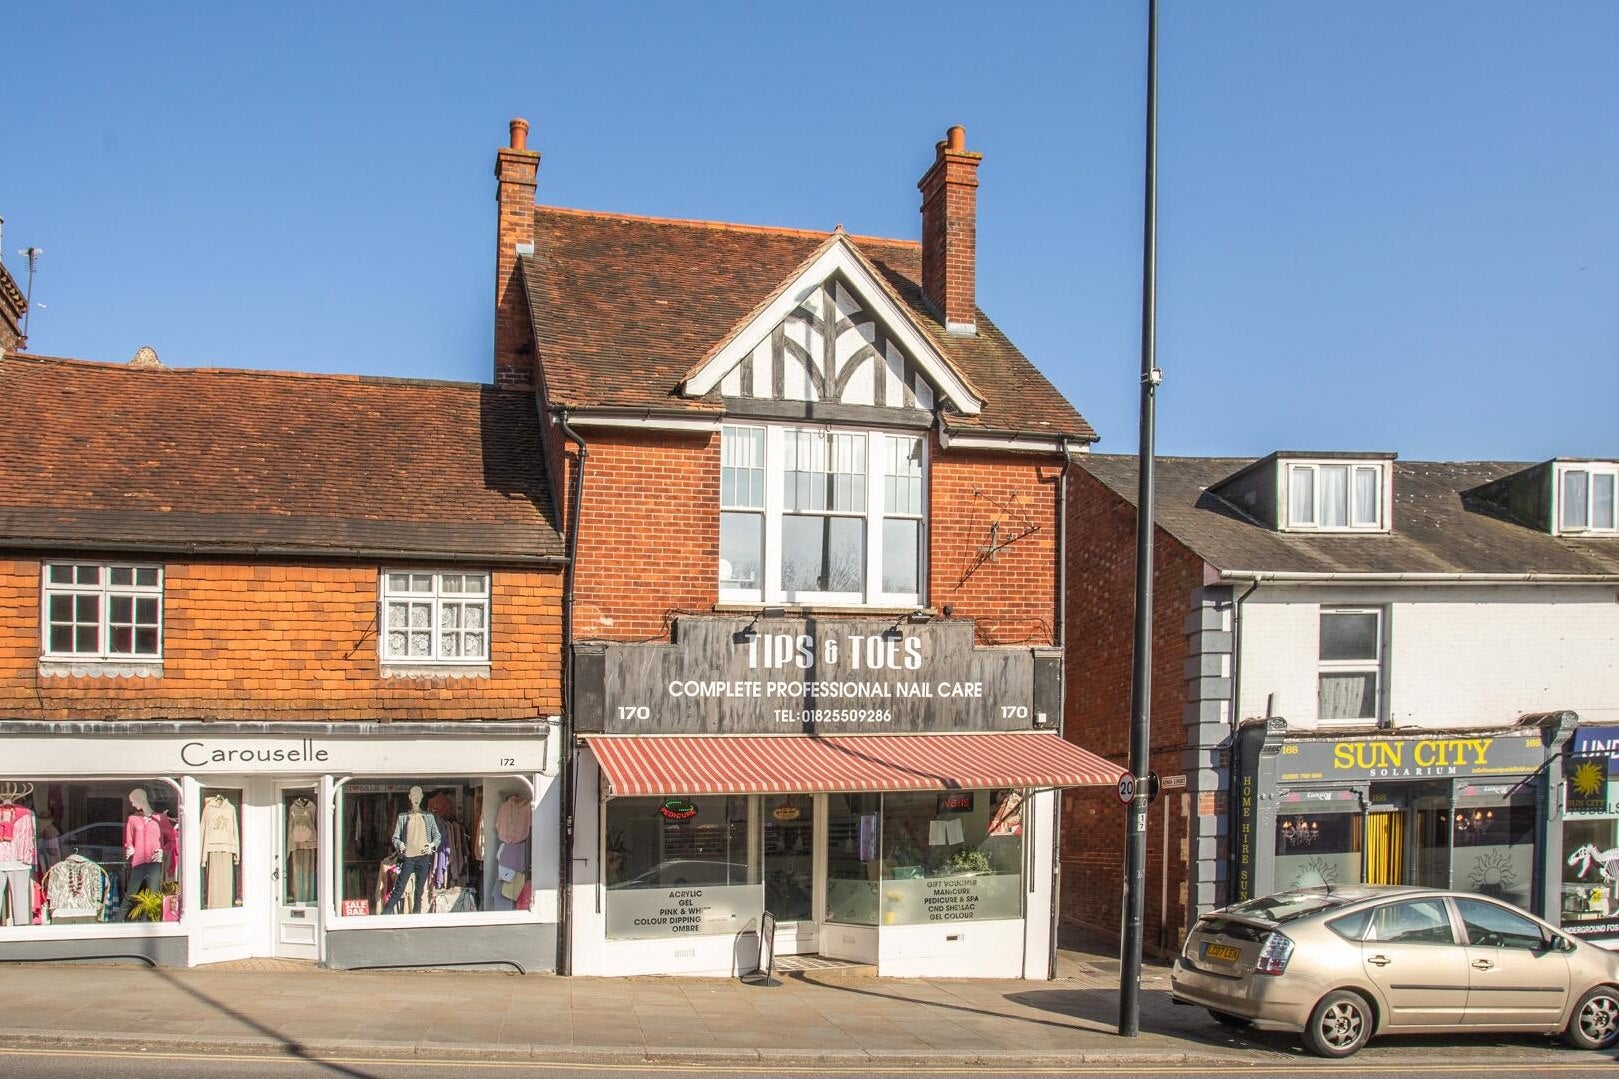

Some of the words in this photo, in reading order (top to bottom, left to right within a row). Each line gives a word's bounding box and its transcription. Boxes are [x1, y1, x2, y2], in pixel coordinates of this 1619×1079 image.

[745, 633, 814, 669] TIPS
[824, 639, 838, 665] &
[848, 635, 922, 670] TOES
[669, 680, 762, 698] COMPLETE
[767, 681, 892, 698] PROFESSIONAL
[897, 681, 933, 698] NAIL
[938, 681, 982, 698] CARE
[618, 706, 650, 720] 170
[1001, 705, 1028, 719] 170
[1525, 738, 1541, 748] 168
[180, 738, 329, 767] Carouselle
[1282, 745, 1299, 755] 168
[1334, 741, 1405, 769] SUN
[1414, 738, 1494, 767] CITY
[499, 758, 515, 767] 172
[1369, 767, 1457, 777] SOLARIUM
[1120, 781, 1134, 795] 20
[1243, 776, 1252, 817] HOME
[1241, 823, 1250, 864] HIRE
[669, 890, 703, 899] ACRYLIC
[344, 900, 367, 909] SALE
[678, 899, 694, 907] GEL
[924, 896, 958, 905] PEDICURE
[966, 895, 979, 903] SPA
[660, 907, 678, 916] PINK
[680, 907, 686, 915] &
[929, 913, 943, 921] GEL
[944, 911, 974, 920] COLOUR
[633, 917, 668, 926] COLOUR
[669, 915, 702, 924] DIPPING
[672, 924, 700, 932] OMBRE
